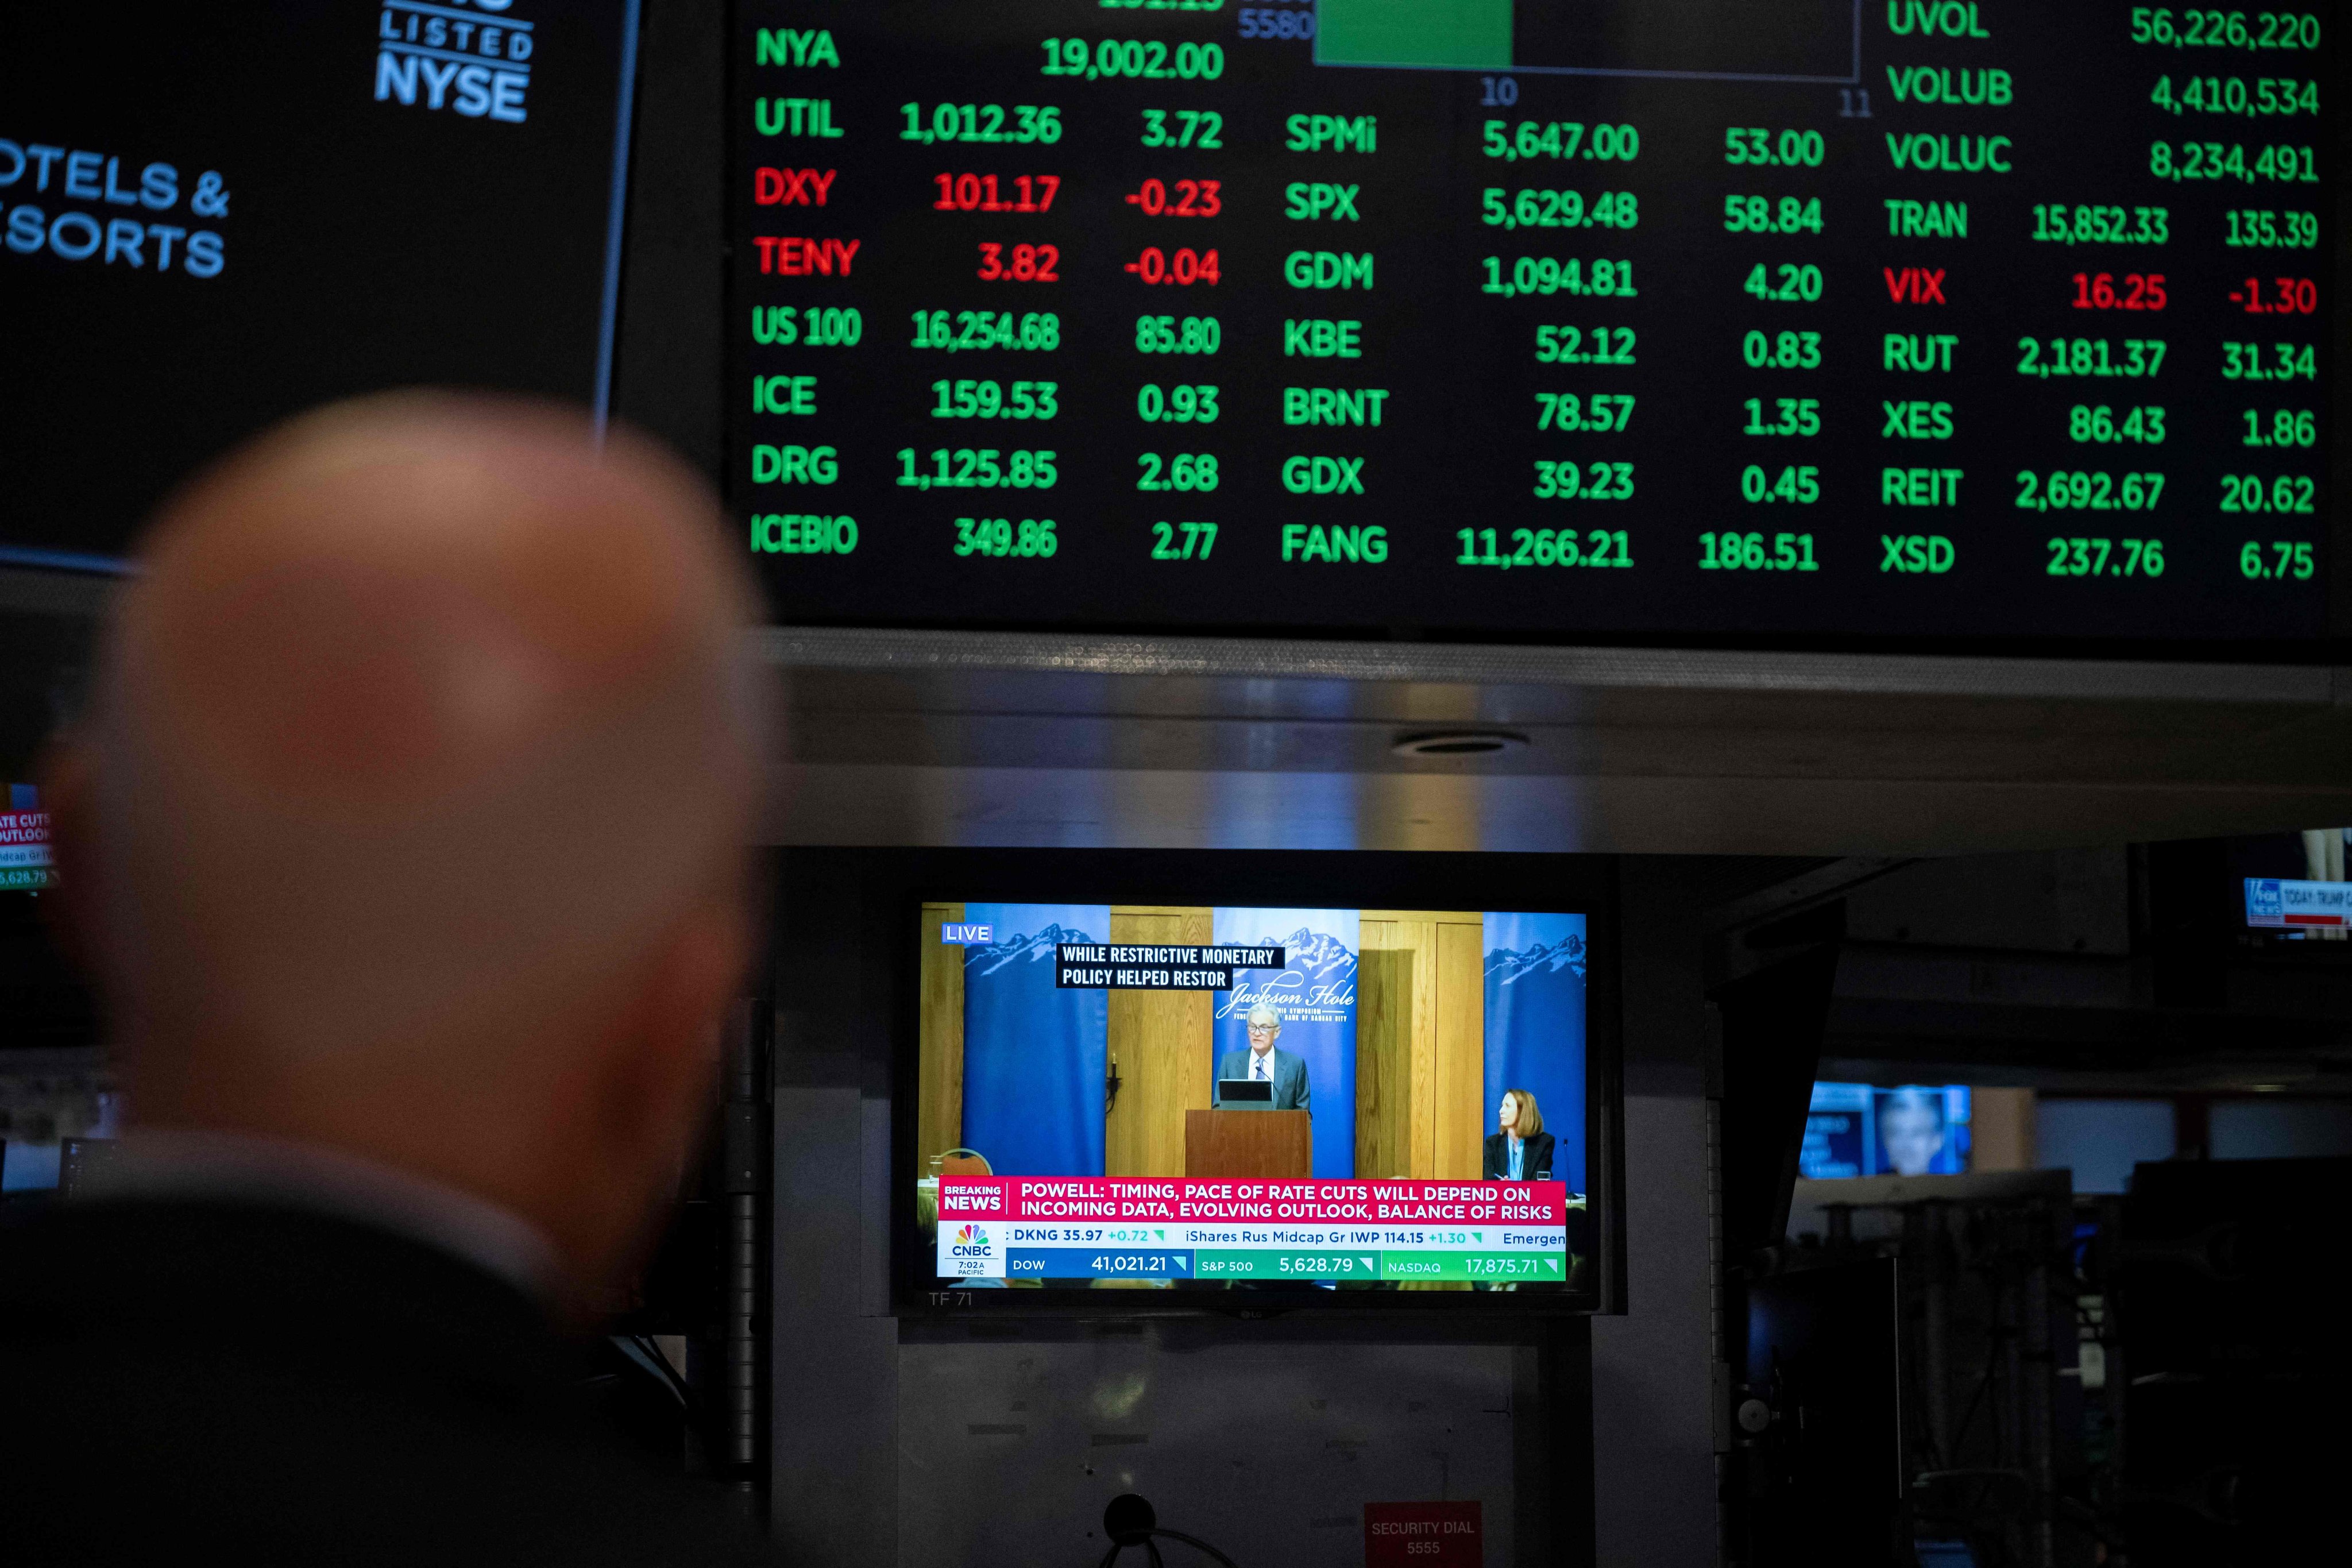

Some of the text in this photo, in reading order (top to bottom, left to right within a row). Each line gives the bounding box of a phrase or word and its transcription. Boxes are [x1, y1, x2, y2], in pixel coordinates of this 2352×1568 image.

[379, 9, 533, 61] LISTED
[1239, 10, 1314, 39] 5580
[1888, 0, 2319, 50] UVOL 56,226,220
[757, 29, 1224, 80] NYA 19,002.00
[375, 51, 530, 122] NYSE
[1482, 77, 1518, 106] 10
[1840, 89, 1870, 118] 11
[1887, 66, 2319, 117] VOLUB 4,410,534
[756, 98, 1222, 148] UTIL 1,012.36 3.72
[1287, 114, 1824, 166] SPMi 5,647.00 53.00
[1886, 133, 2318, 183] VOLUC 8,234,491
[192, 171, 229, 217] &
[755, 167, 1221, 217] DXY 101.17 -0.23
[1286, 183, 1823, 233] SPX 5,629.48 58.84
[0, 204, 224, 277] SORTS
[1885, 200, 2318, 248] TRAN 15,852.33 135.39
[754, 237, 1221, 285] TENY 3.82 -0.04
[1285, 251, 1822, 301] GDM 1,094.81 4.20
[1884, 268, 2316, 314] VIX 16.25 -1.30
[752, 306, 1221, 354] US 100 16,254.68 85.80
[1285, 319, 1821, 368] KBE 52.12 0.83
[1884, 334, 2316, 380] RUT 2,181.37 31.34
[754, 376, 1219, 423] ICE 159.53 0.93
[1284, 388, 1820, 436] BRNT 78.57 1.35
[1883, 401, 2315, 446] XES 86.43 1.86
[753, 445, 1218, 491] DRG 1,125.85 2.68
[1283, 456, 1819, 503] GDX 39.23 0.45
[1883, 468, 2314, 512] REIT 2,692.67 20.62
[751, 515, 1218, 559] ICEBIO 349.86 2.77
[1283, 524, 1818, 570] FANG 11,266.21 186.51
[1881, 535, 2314, 578] XSD 237.76 6.75
[947, 926, 989, 940] LIVE
[1063, 947, 1274, 964] WHILE RESTRICTIVE MONETARY
[1064, 970, 1225, 986] POLICY HELPED RESTOR
[1216, 971, 1355, 1019] Jackson Hole
[945, 1186, 1001, 1195] BREAKING
[945, 1196, 1001, 1210] NEWS
[1022, 1183, 1530, 1201] POWELL: TIMING, PACE OF RATE CUTS WILL DEPEND ON
[1022, 1202, 1551, 1221] INCOMING DATA, EVOLVING OUTLOOK, BALANCE OF RISKS
[952, 1246, 991, 1256] CNBC
[1015, 1230, 1057, 1240] DKNG
[1064, 1230, 1102, 1241] 35.97
[1109, 1230, 1148, 1241] +0.72
[1187, 1231, 1466, 1245] iShares Rus Midcap Gr IWP 114.15 +1.30
[1504, 1234, 1565, 1246] Emergen
[1014, 1257, 1165, 1272] DOW 41,021.21
[1202, 1258, 1353, 1273] S&P 500 5,628.79
[1389, 1259, 1536, 1275] NASDAQ 17,875.71
[929, 1292, 971, 1306] TF 71
[1372, 1521, 1474, 1535] SECURITY DIAL
[1408, 1542, 1440, 1554] 5555
